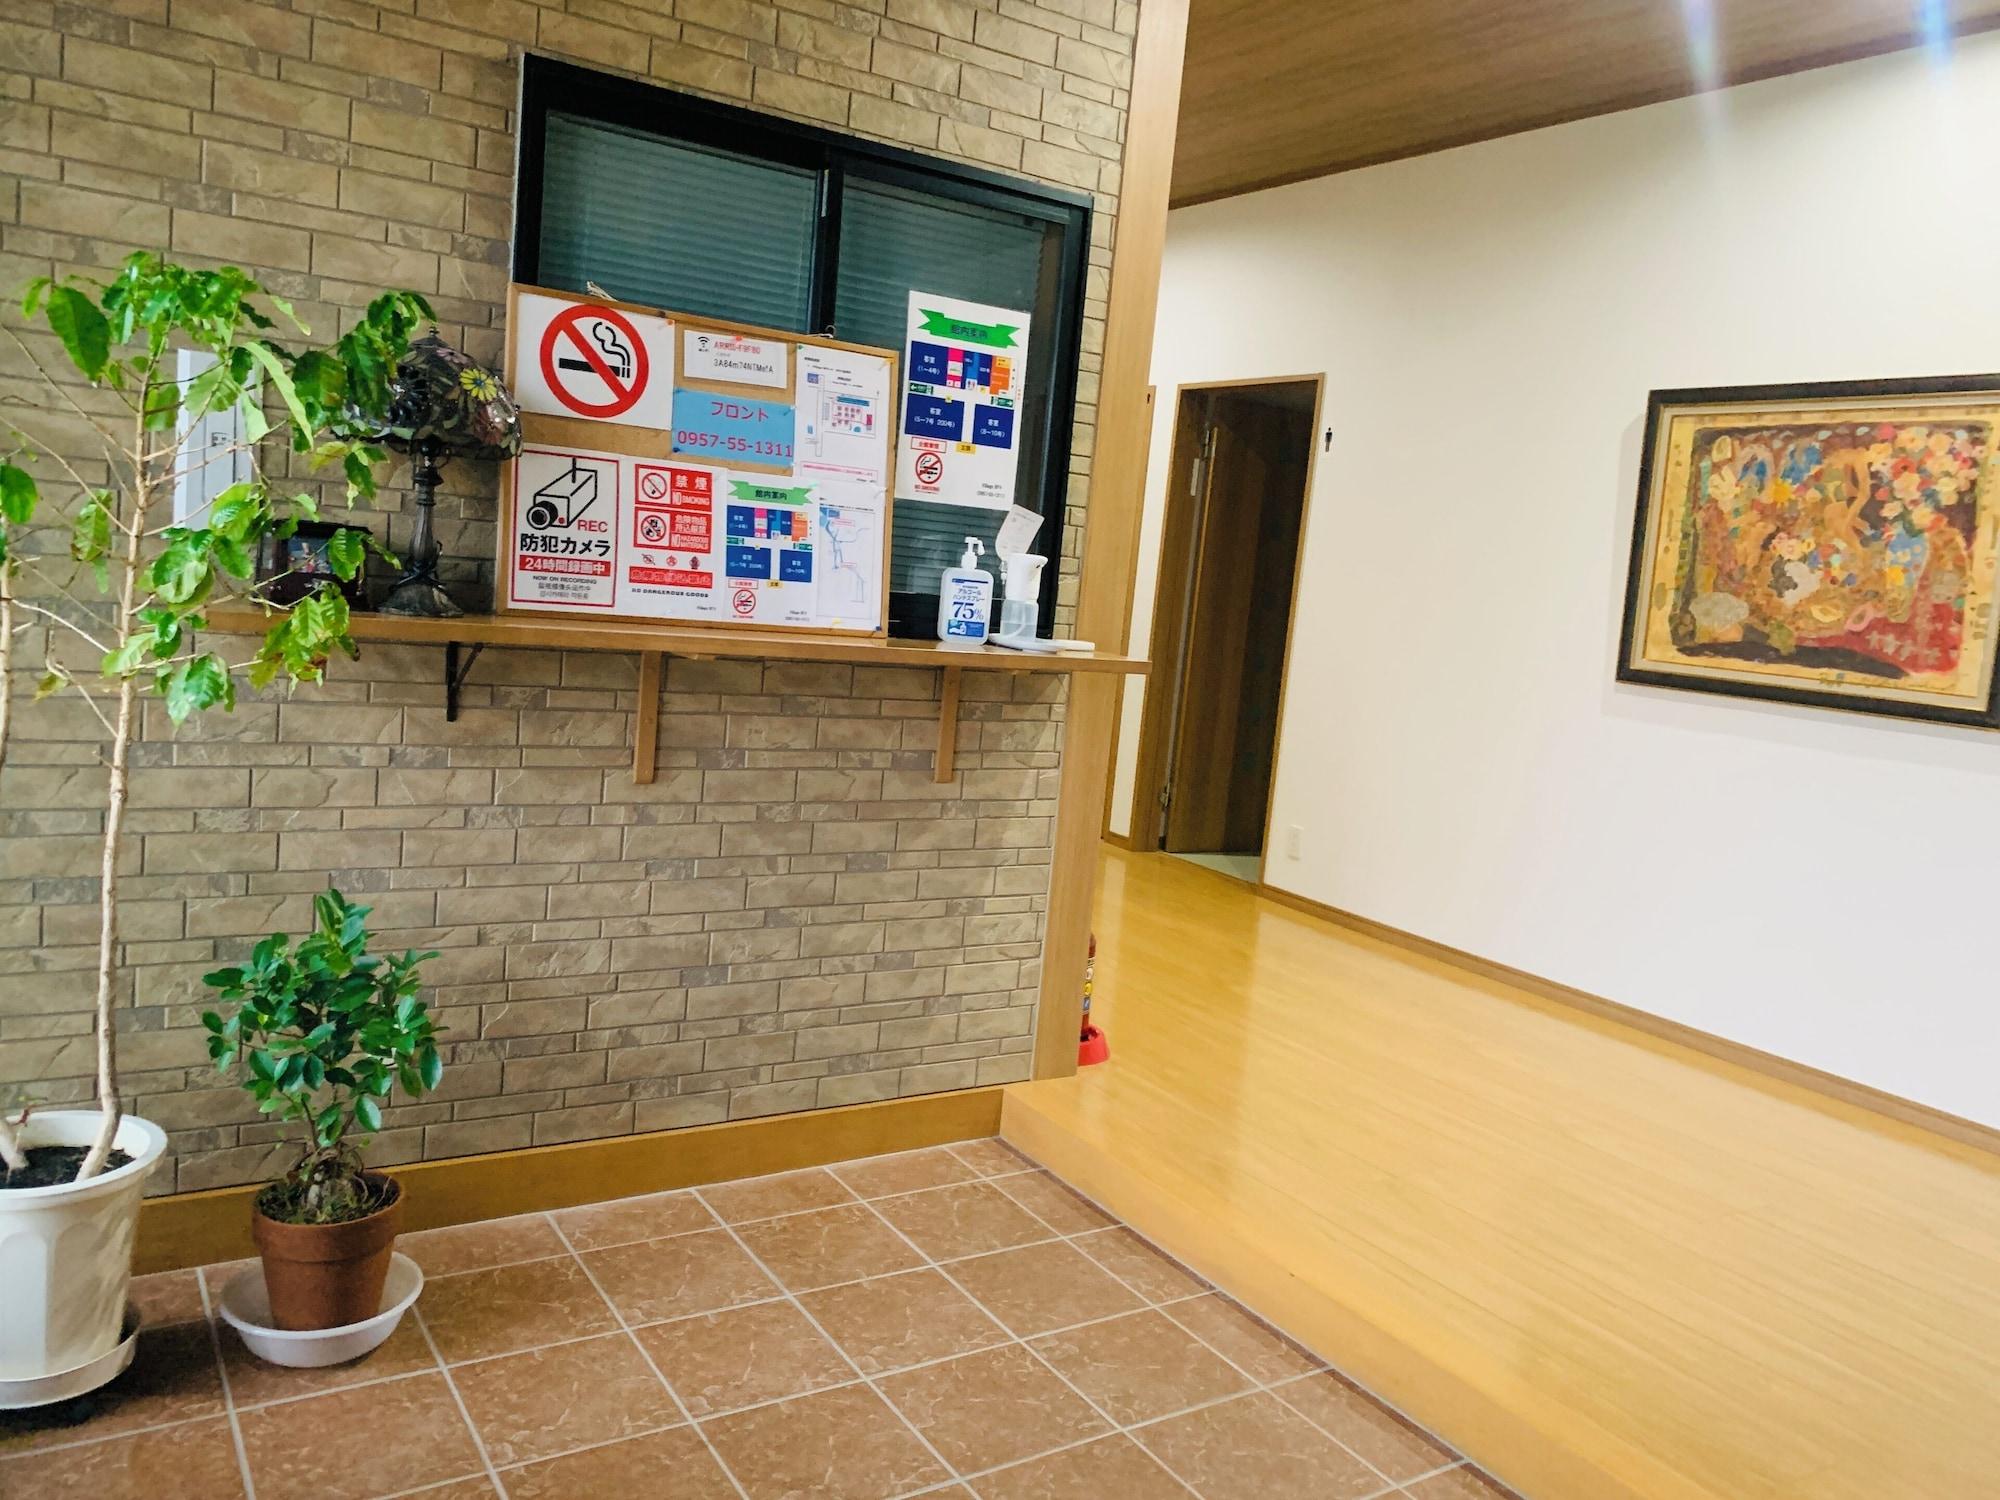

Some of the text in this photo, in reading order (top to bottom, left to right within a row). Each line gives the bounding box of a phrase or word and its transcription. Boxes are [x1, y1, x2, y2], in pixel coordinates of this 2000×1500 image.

[711, 401, 769, 422] フロント
[677, 430, 793, 458] 0957-55-1311
[577, 519, 608, 533] REC
[520, 533, 611, 557] 防犯カメラ
[525, 557, 606, 575] 24時間録画中
[952, 601, 984, 620] 75%
